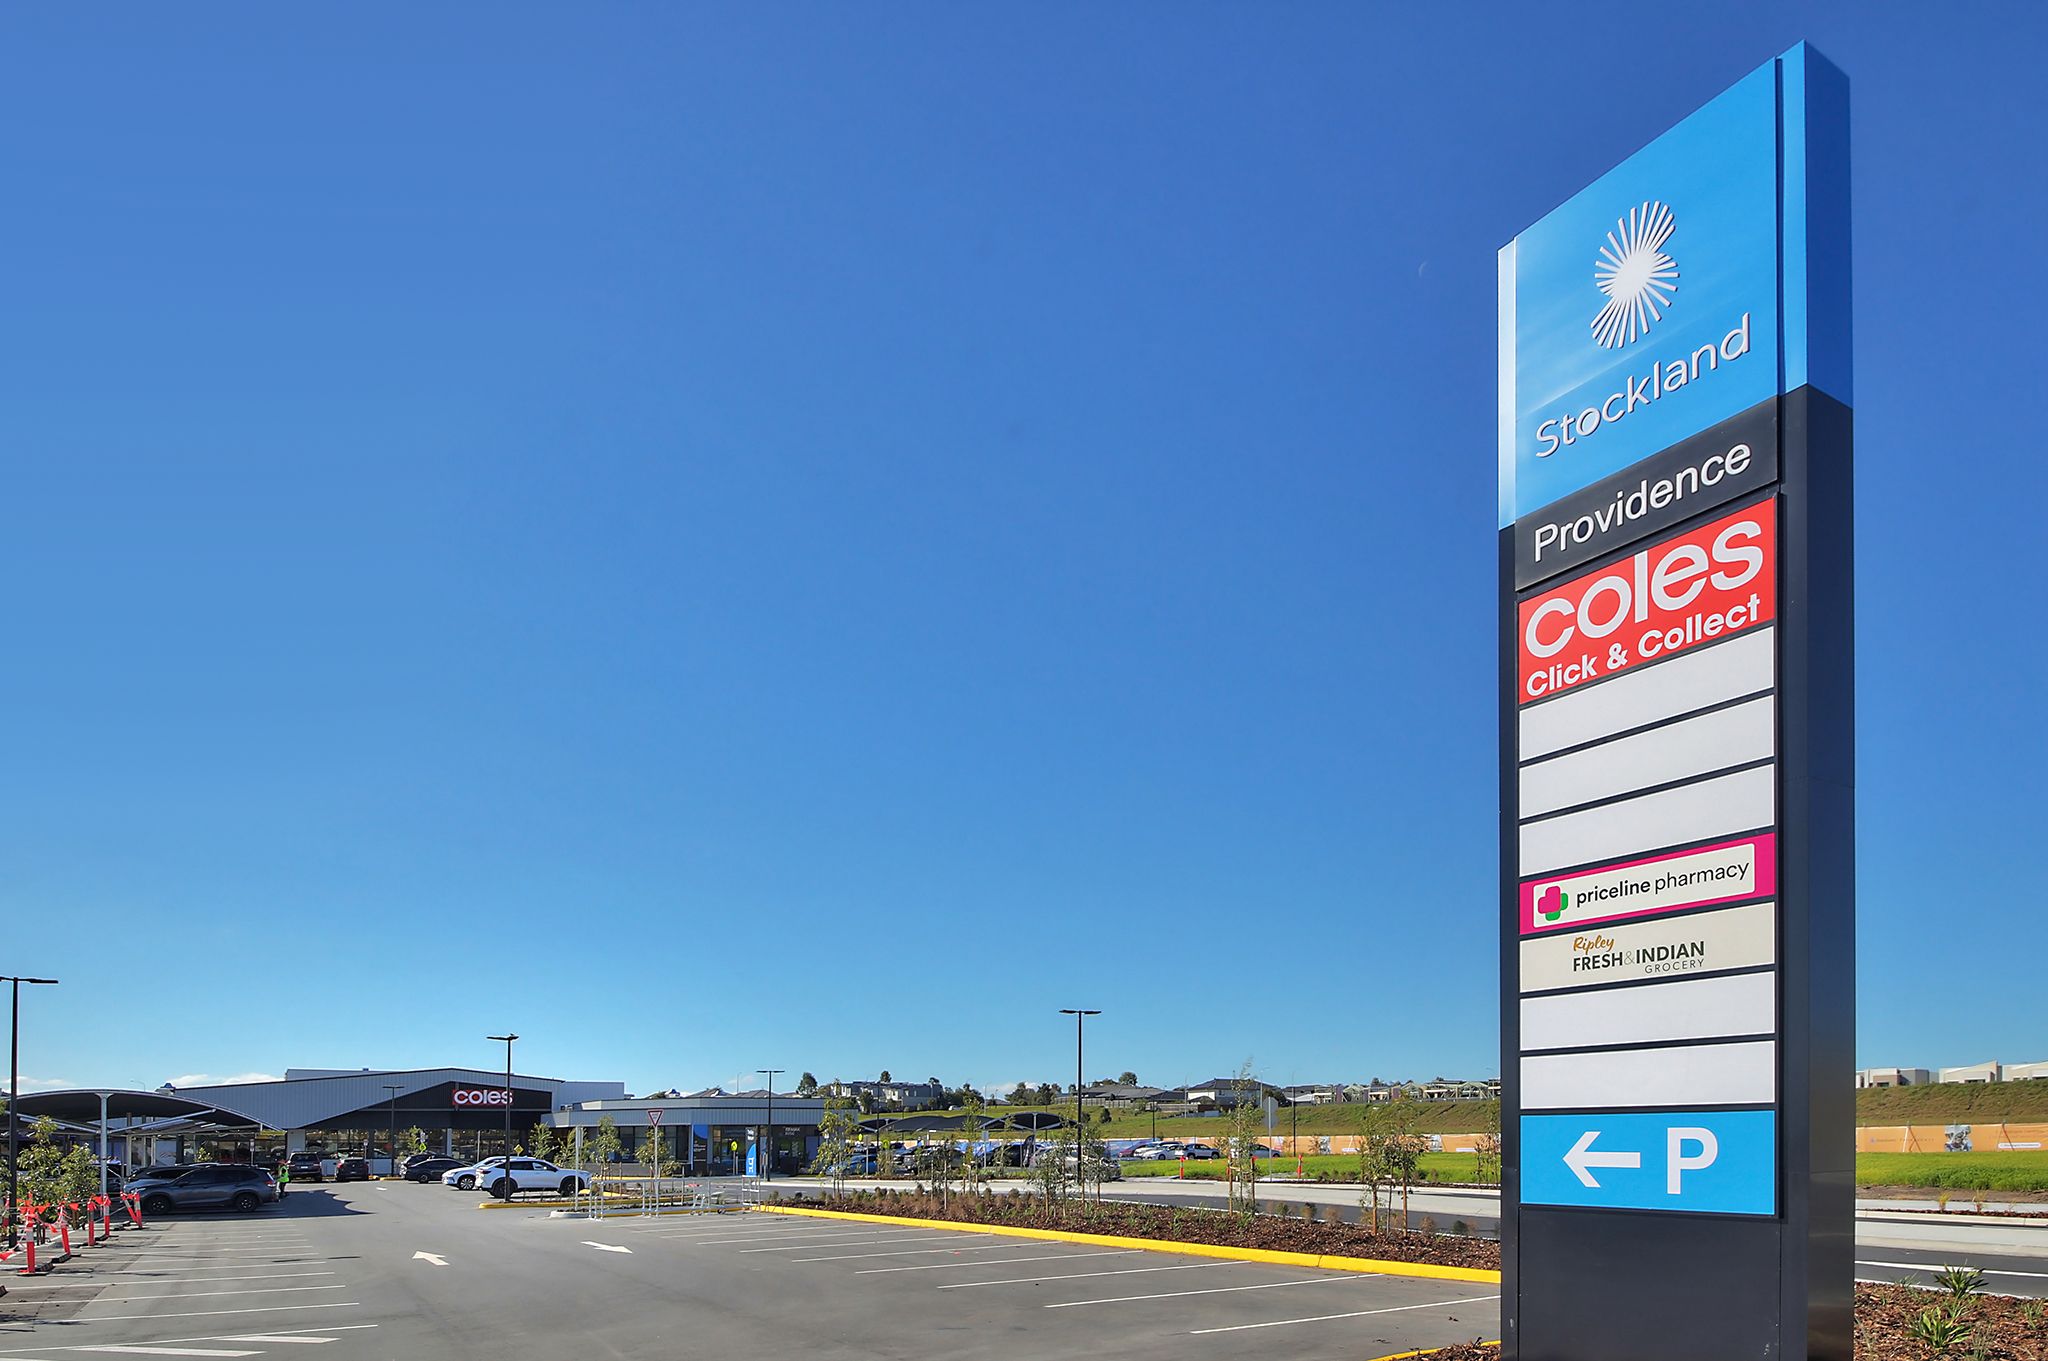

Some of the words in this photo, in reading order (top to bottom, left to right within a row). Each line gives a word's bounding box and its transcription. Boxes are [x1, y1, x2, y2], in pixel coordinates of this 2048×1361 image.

[1535, 312, 1750, 458] Stockland
[1534, 443, 1751, 563] Providence
[1525, 520, 1764, 659] coles
[1526, 654, 1598, 697] Click
[1606, 642, 1628, 670] &
[1638, 593, 1761, 658] Collect
[1576, 879, 1651, 908] priceline
[1654, 862, 1750, 894] pharmacy
[1573, 934, 1615, 956] Ripley
[1644, 958, 1705, 974] GROCERY
[454, 1089, 513, 1105] coles
[1666, 1126, 1719, 1195] P
